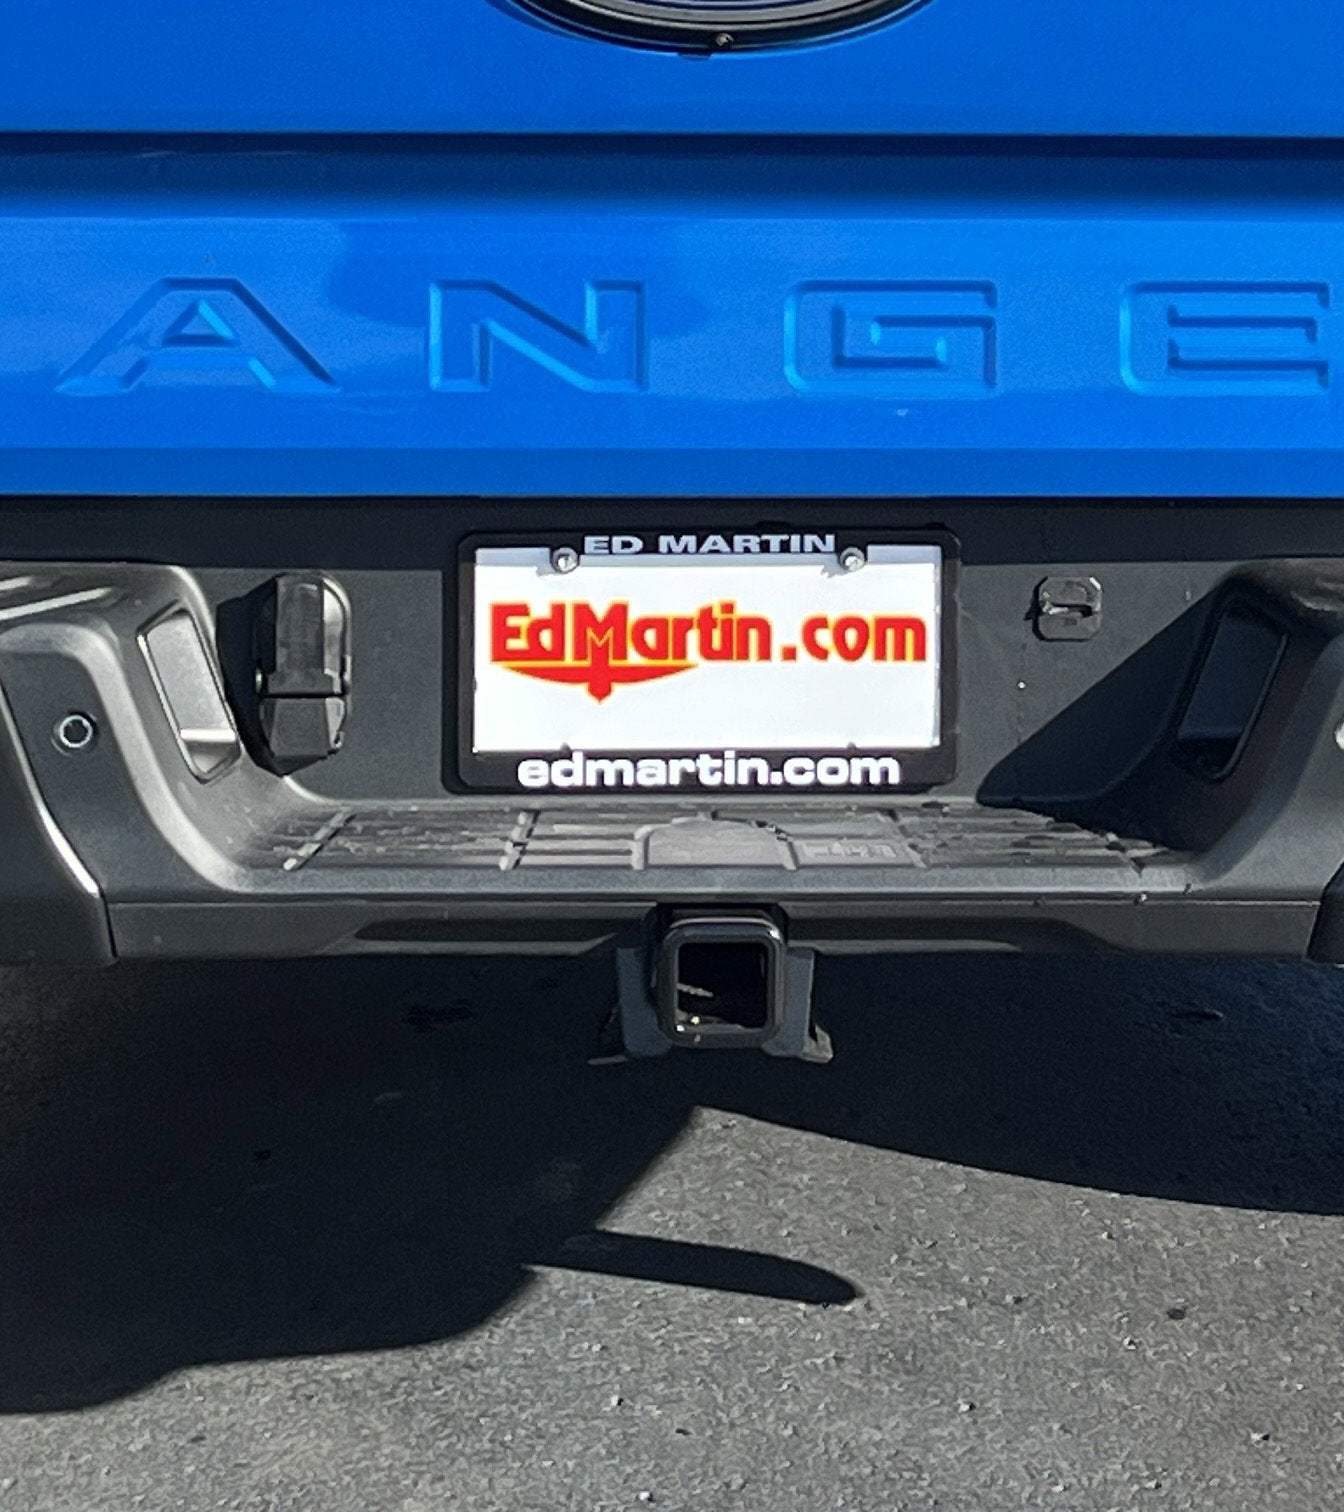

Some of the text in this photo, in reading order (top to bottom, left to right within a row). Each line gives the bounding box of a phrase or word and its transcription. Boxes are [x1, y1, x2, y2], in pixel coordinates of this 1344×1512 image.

[584, 533, 836, 555] ED MARTIN
[516, 751, 901, 787] edmartin.com
